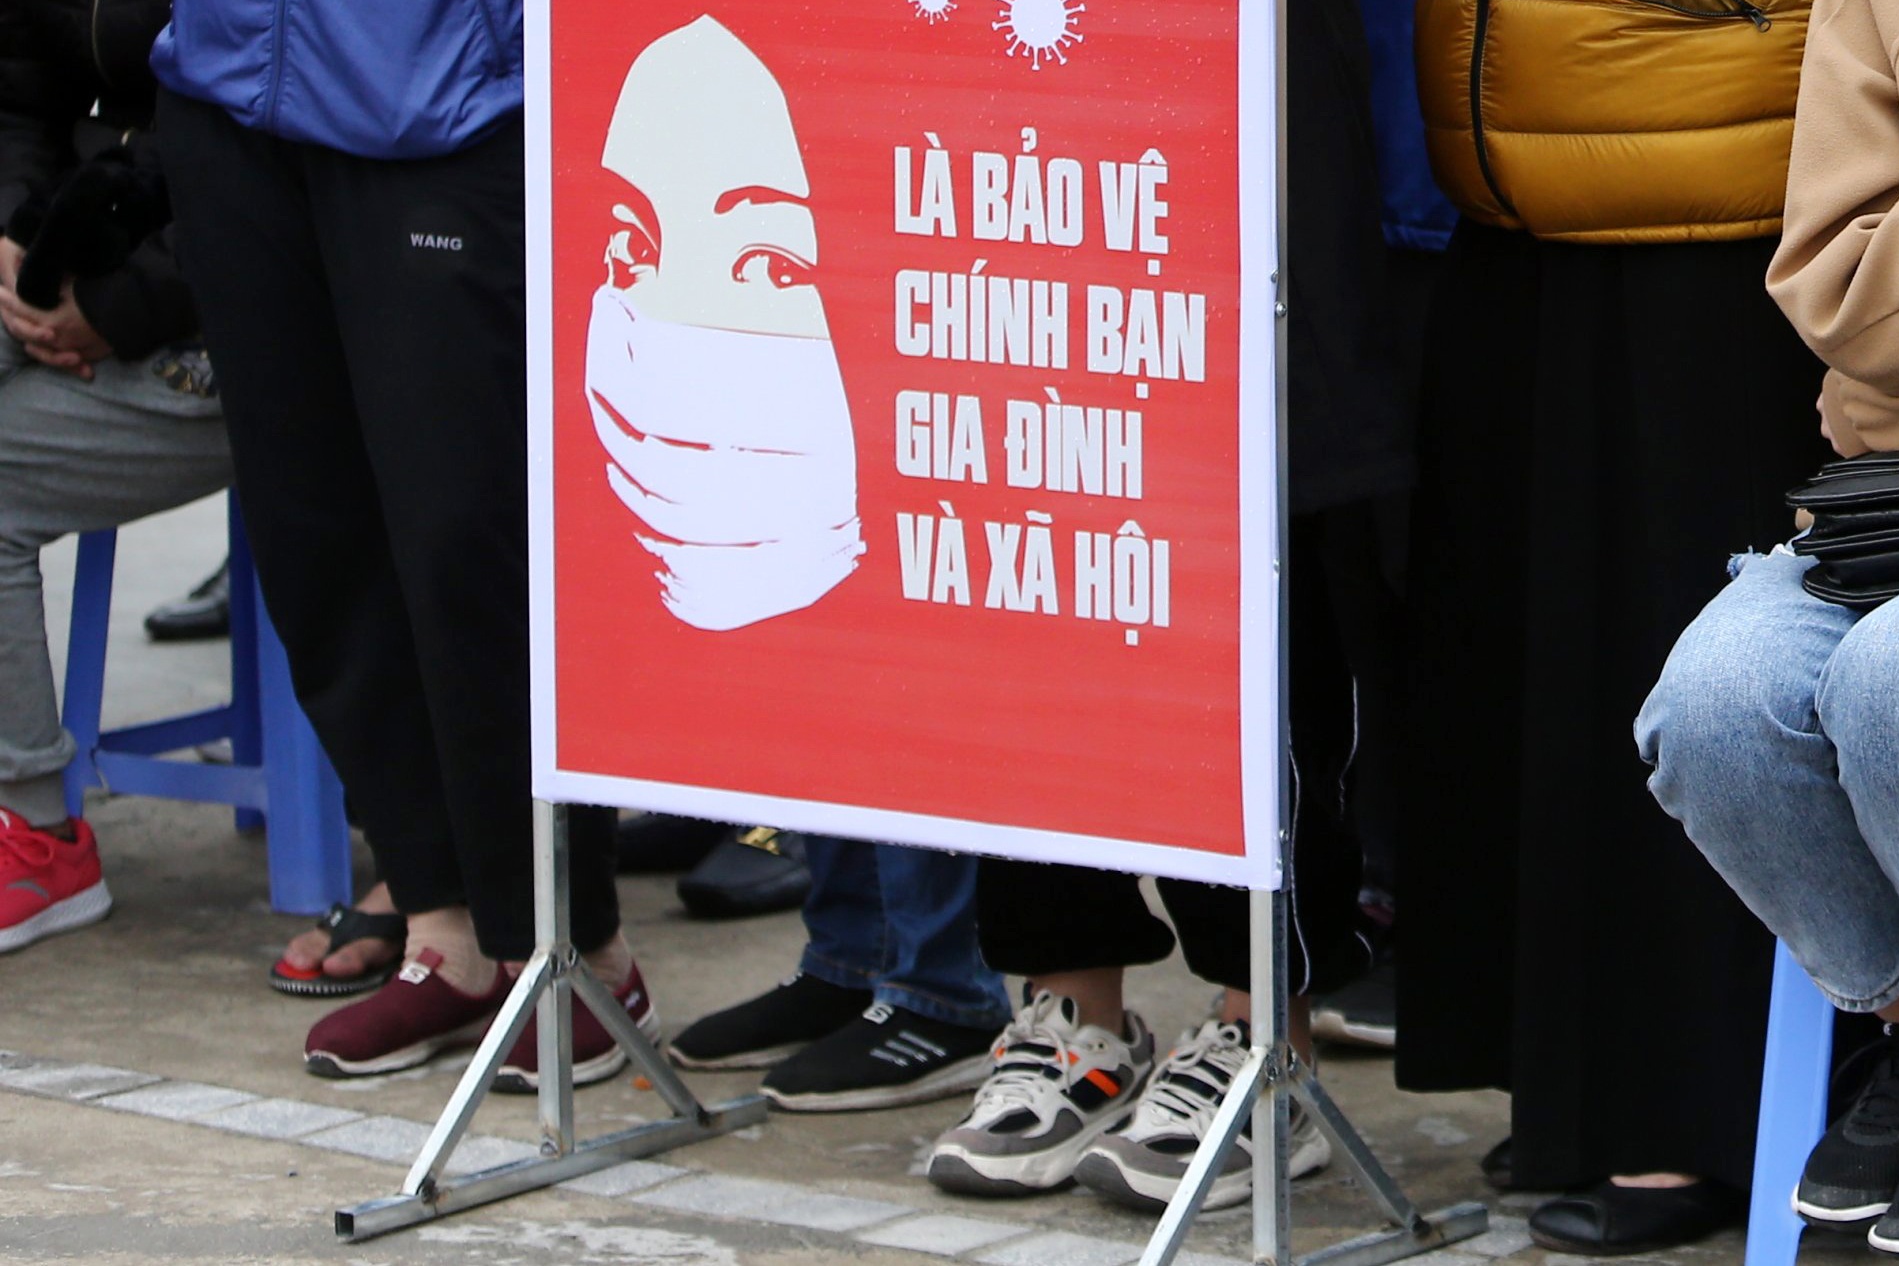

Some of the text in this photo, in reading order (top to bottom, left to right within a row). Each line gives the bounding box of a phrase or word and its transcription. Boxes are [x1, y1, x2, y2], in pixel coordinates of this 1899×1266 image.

[410, 232, 463, 251] WANG
[893, 126, 1170, 276] LÀ BẢO VỆ
[894, 259, 1206, 399] CHÍNH BẠN
[894, 386, 1143, 500] GIA ĐÌNH
[895, 500, 1170, 646] VÀ XÃ HỘI
